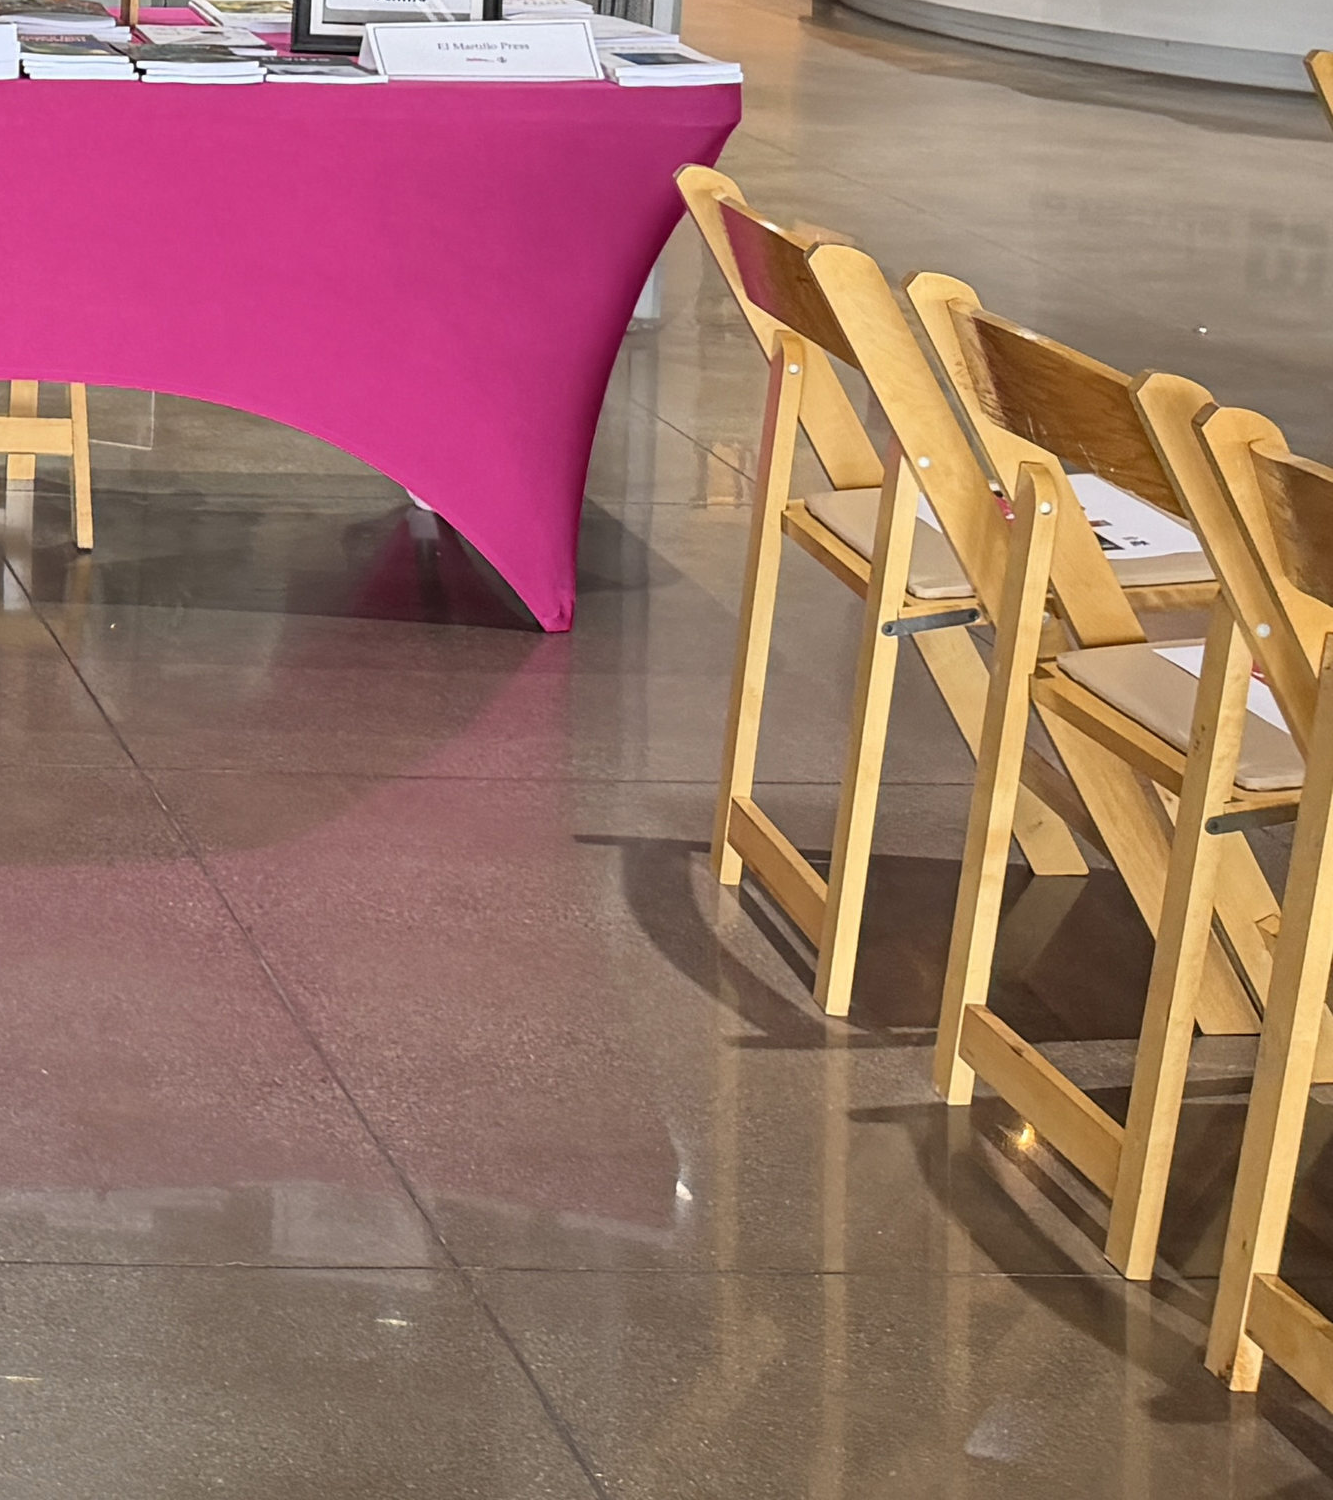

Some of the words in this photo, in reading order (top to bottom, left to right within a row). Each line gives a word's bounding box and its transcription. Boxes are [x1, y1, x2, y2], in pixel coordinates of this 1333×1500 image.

[437, 43, 450, 51] El
[452, 42, 498, 51] Martillo
[501, 42, 530, 51] Press
